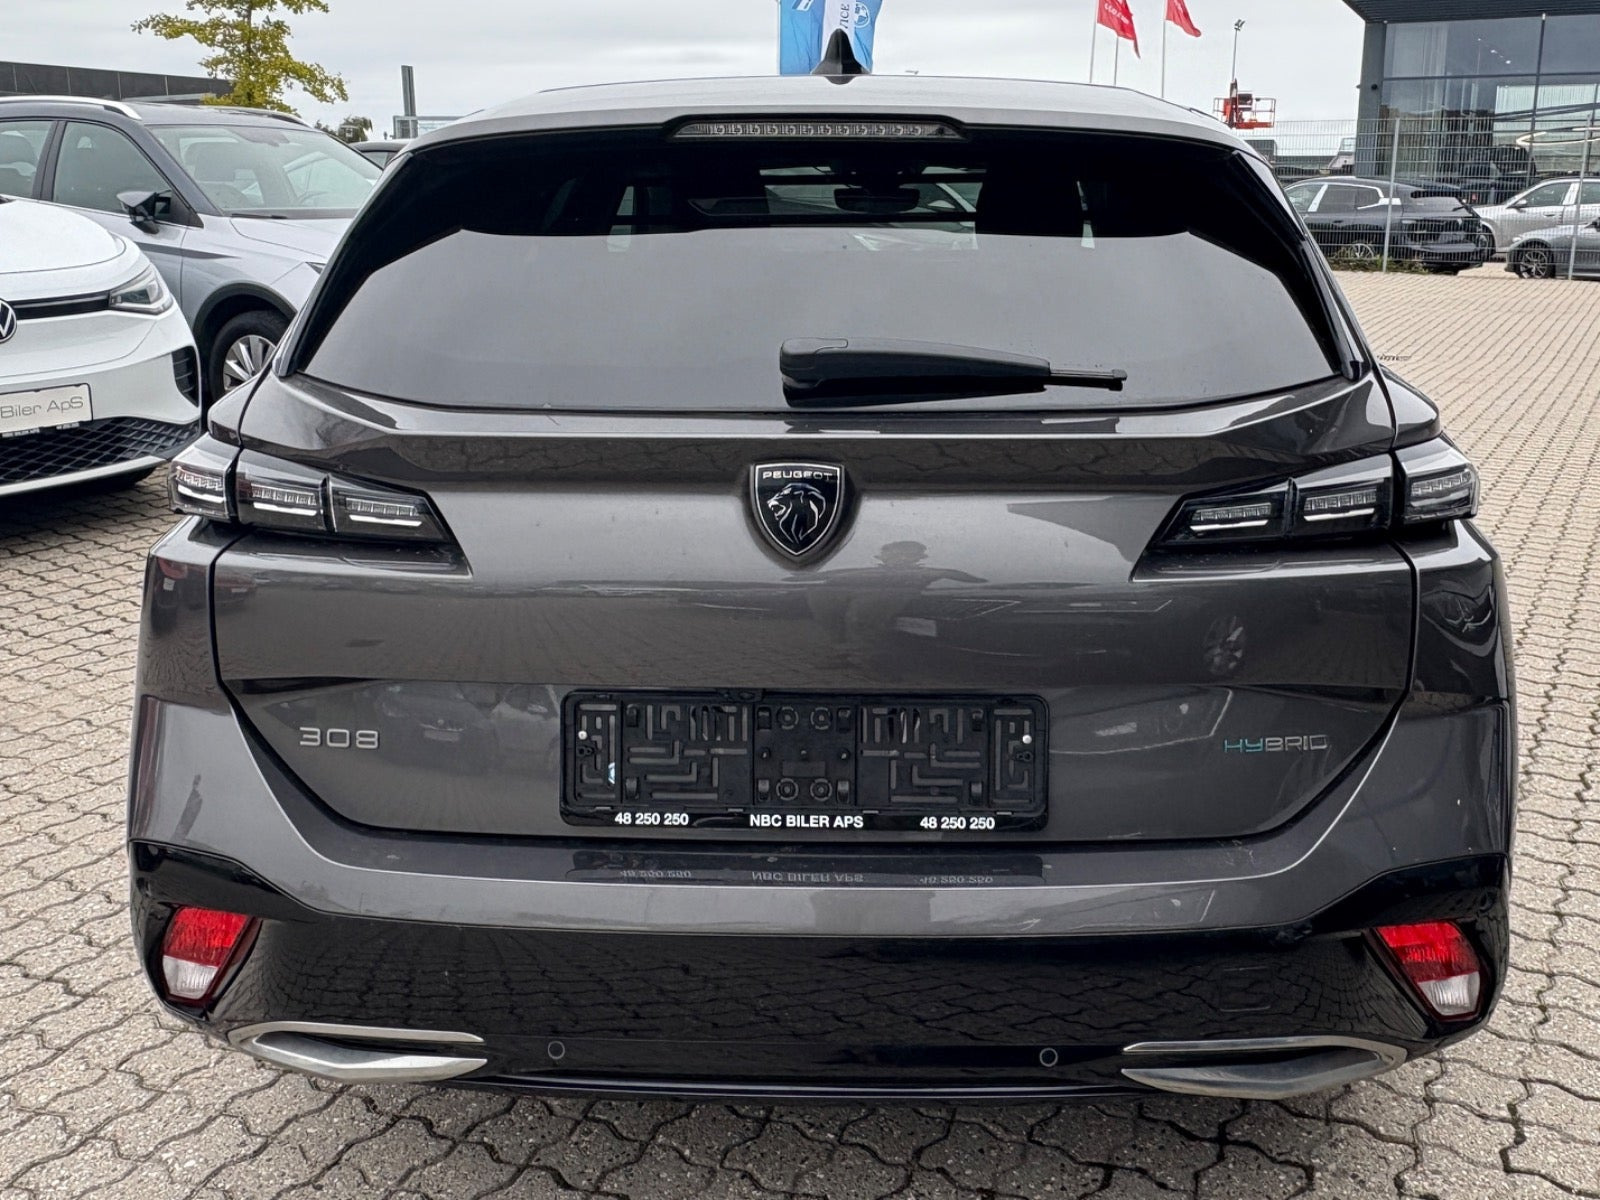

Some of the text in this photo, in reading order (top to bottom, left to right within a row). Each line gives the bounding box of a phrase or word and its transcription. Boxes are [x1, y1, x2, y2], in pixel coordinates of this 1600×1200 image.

[0, 396, 84, 419] Biler ApS
[762, 470, 833, 480] PEUGEOT
[299, 727, 379, 749] 308
[1224, 734, 1328, 753] HYBRID
[614, 812, 690, 826] 48 250 250
[749, 814, 864, 828] NBC BILER APS
[920, 816, 996, 830] 48 250 250
